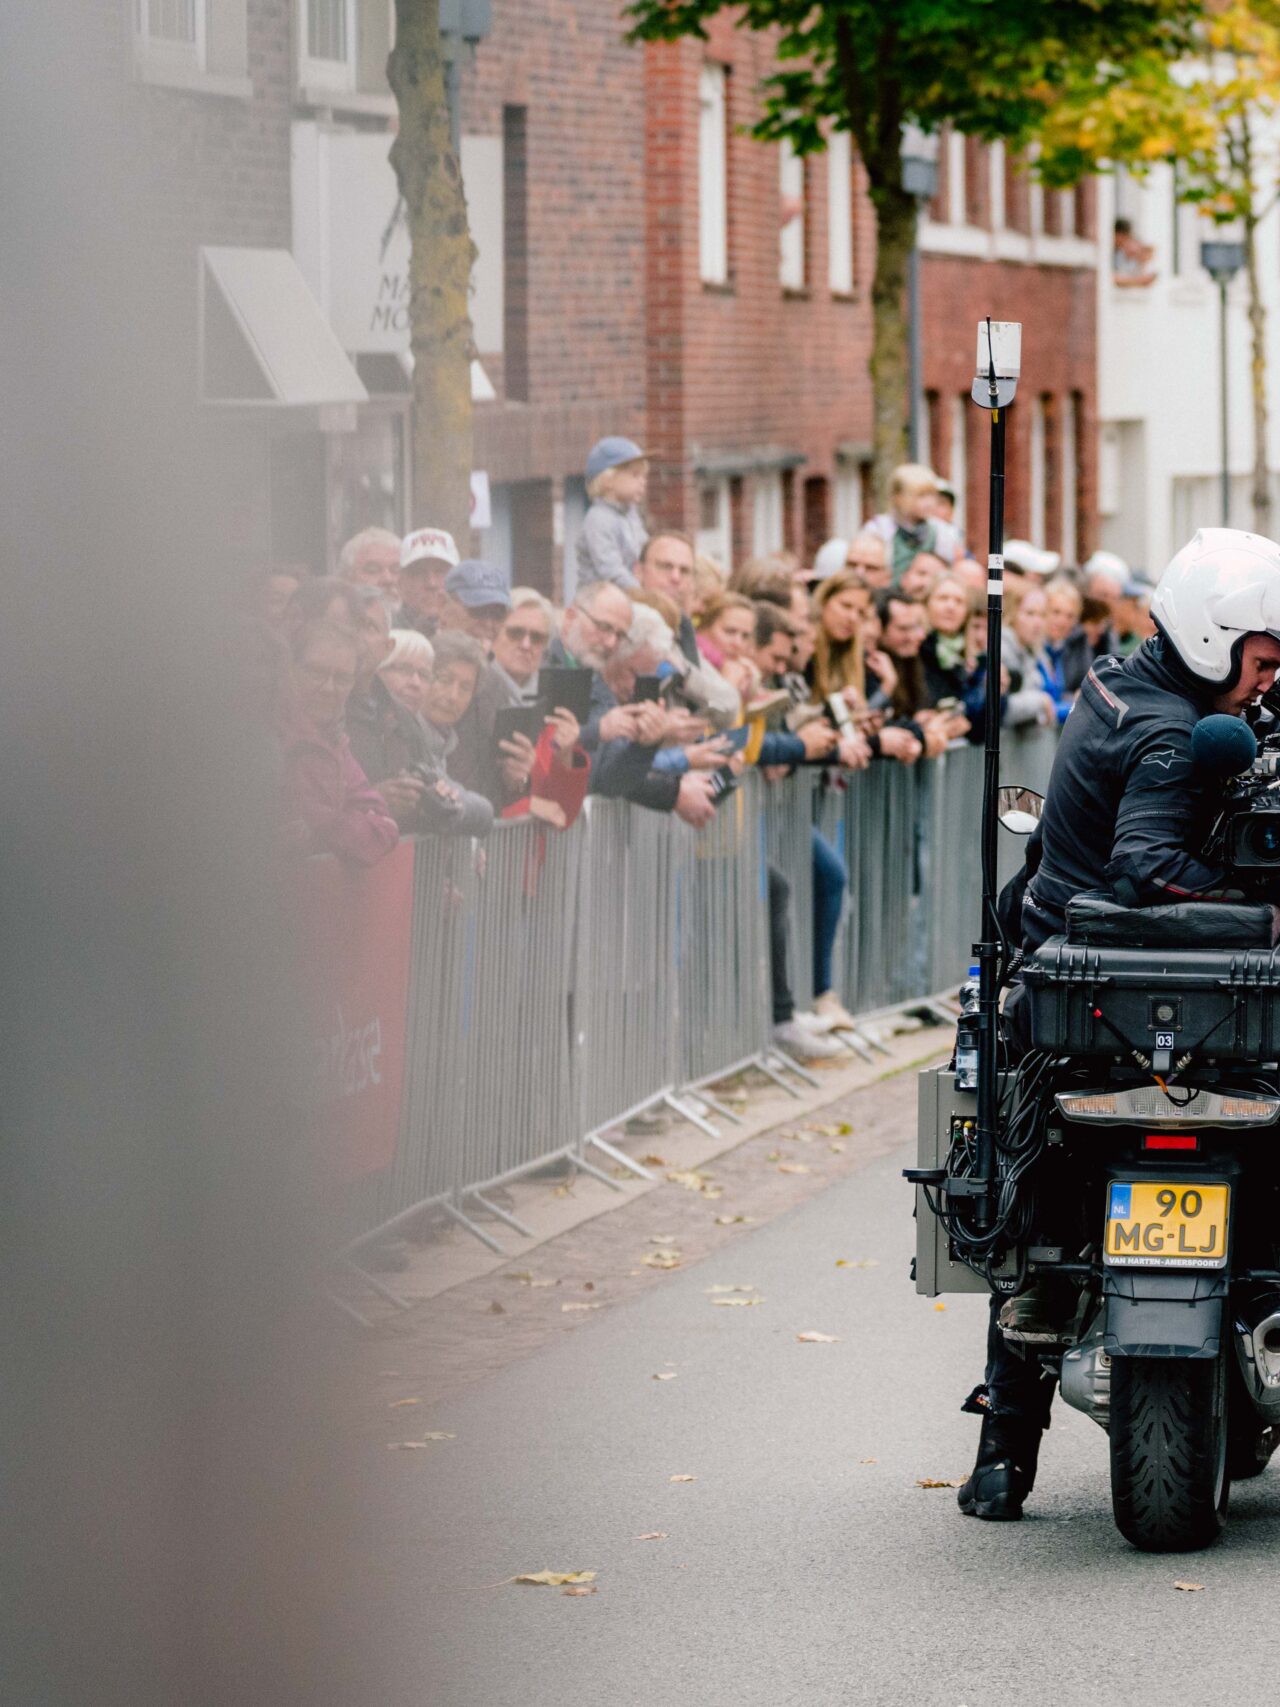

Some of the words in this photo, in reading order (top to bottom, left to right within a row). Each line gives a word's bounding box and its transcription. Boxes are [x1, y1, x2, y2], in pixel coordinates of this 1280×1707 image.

[1158, 1035, 1172, 1047] 03
[1156, 1189, 1203, 1218] 90
[1113, 1205, 1127, 1215] NL
[1114, 1222, 1217, 1253] MG-LJ
[1109, 1257, 1126, 1265] VAN
[1000, 1281, 1014, 1289] 09
